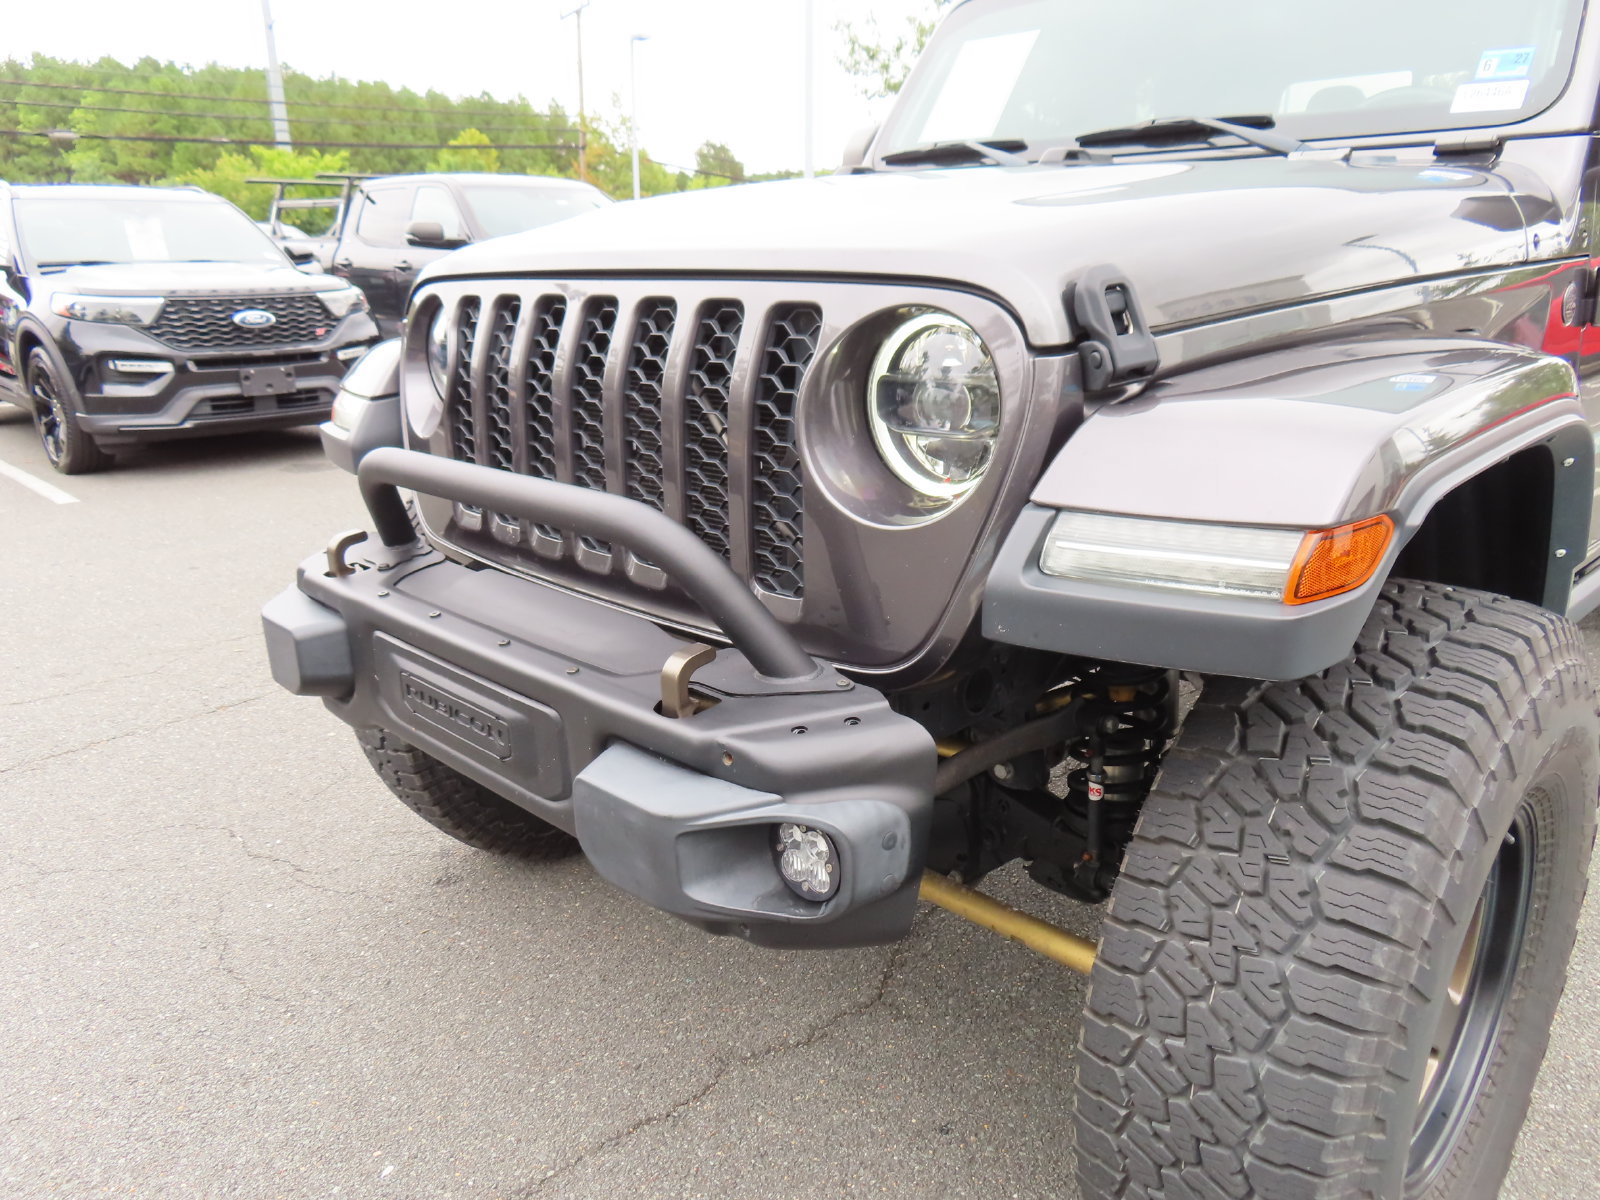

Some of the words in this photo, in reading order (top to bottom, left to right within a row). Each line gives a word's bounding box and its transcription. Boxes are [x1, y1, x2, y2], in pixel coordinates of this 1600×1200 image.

[1483, 59, 1492, 72] 6
[1514, 52, 1531, 65] 27
[404, 683, 505, 746] RUBICON
[1088, 786, 1102, 797] KS
